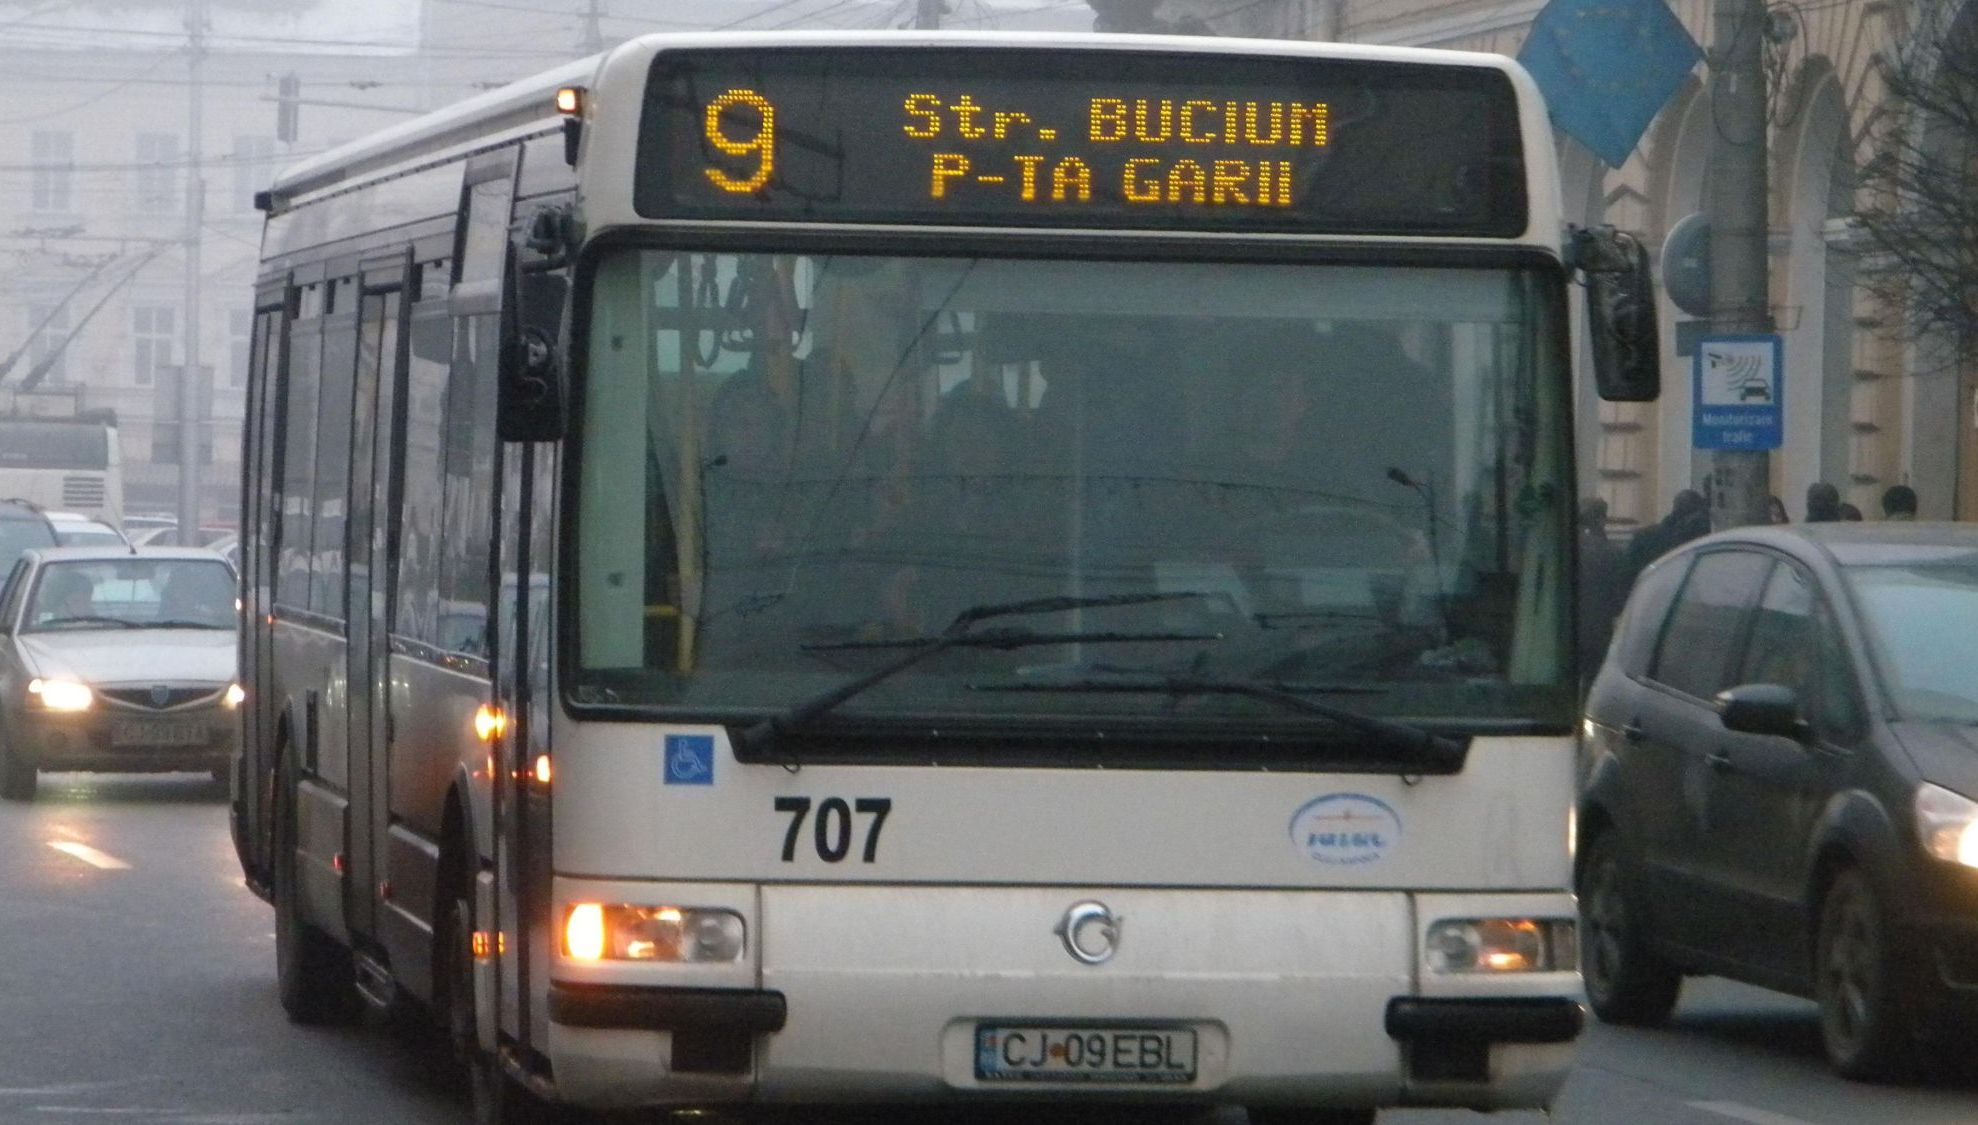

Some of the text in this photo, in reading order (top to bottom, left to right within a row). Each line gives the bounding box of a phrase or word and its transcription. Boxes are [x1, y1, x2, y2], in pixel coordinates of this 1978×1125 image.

[705, 89, 774, 193] 9
[904, 93, 1327, 146] Str. BUCIUM
[931, 153, 1291, 204] P-TA GARII
[774, 796, 891, 863] 707
